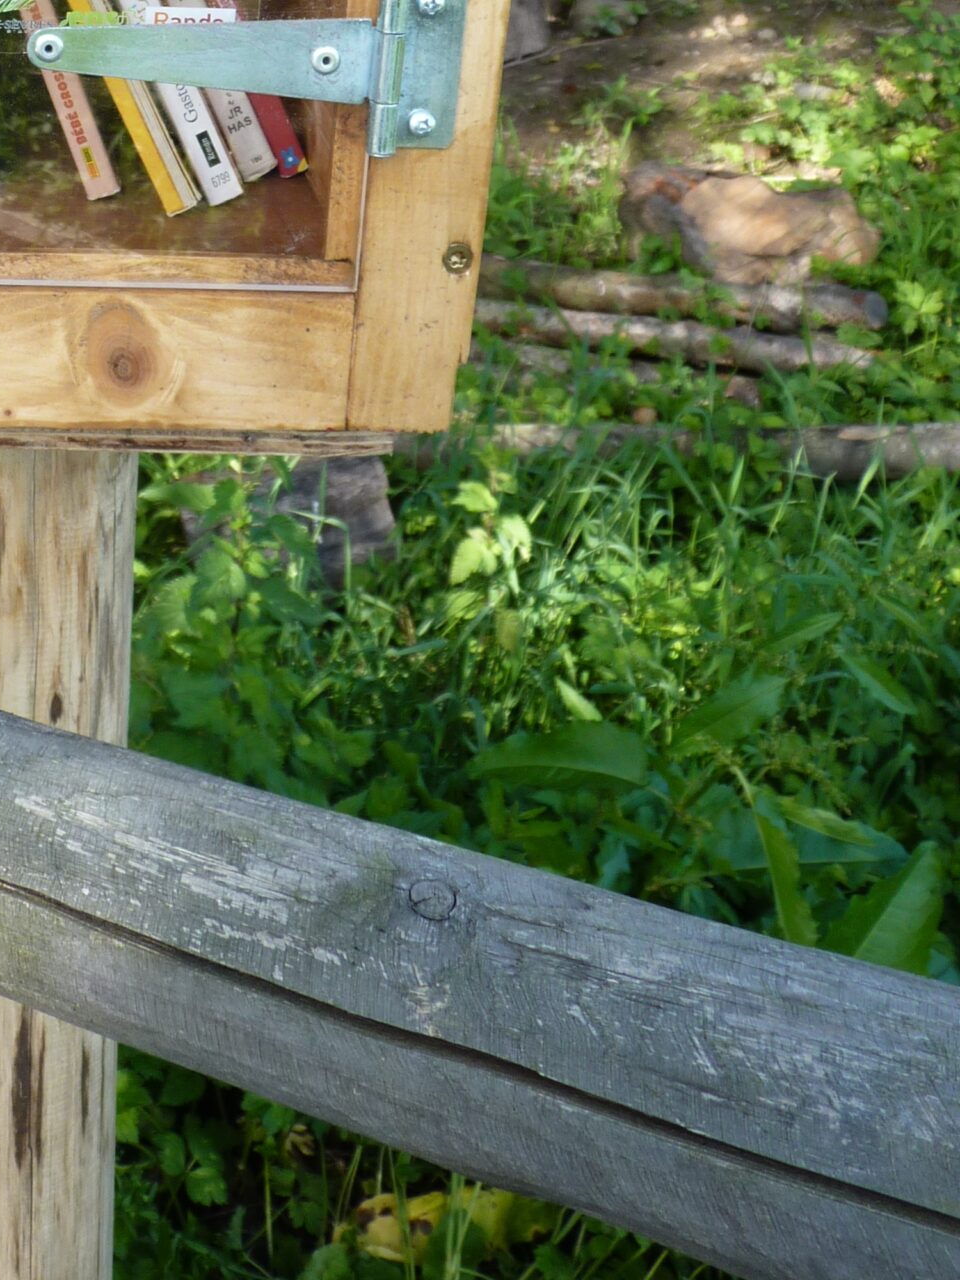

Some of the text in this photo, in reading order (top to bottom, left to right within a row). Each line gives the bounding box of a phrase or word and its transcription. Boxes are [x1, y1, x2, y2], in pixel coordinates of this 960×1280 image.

[52, 70, 74, 109] GROS
[175, 83, 198, 123] Gasto
[226, 116, 253, 134] HAS
[227, 105, 244, 120] JR
